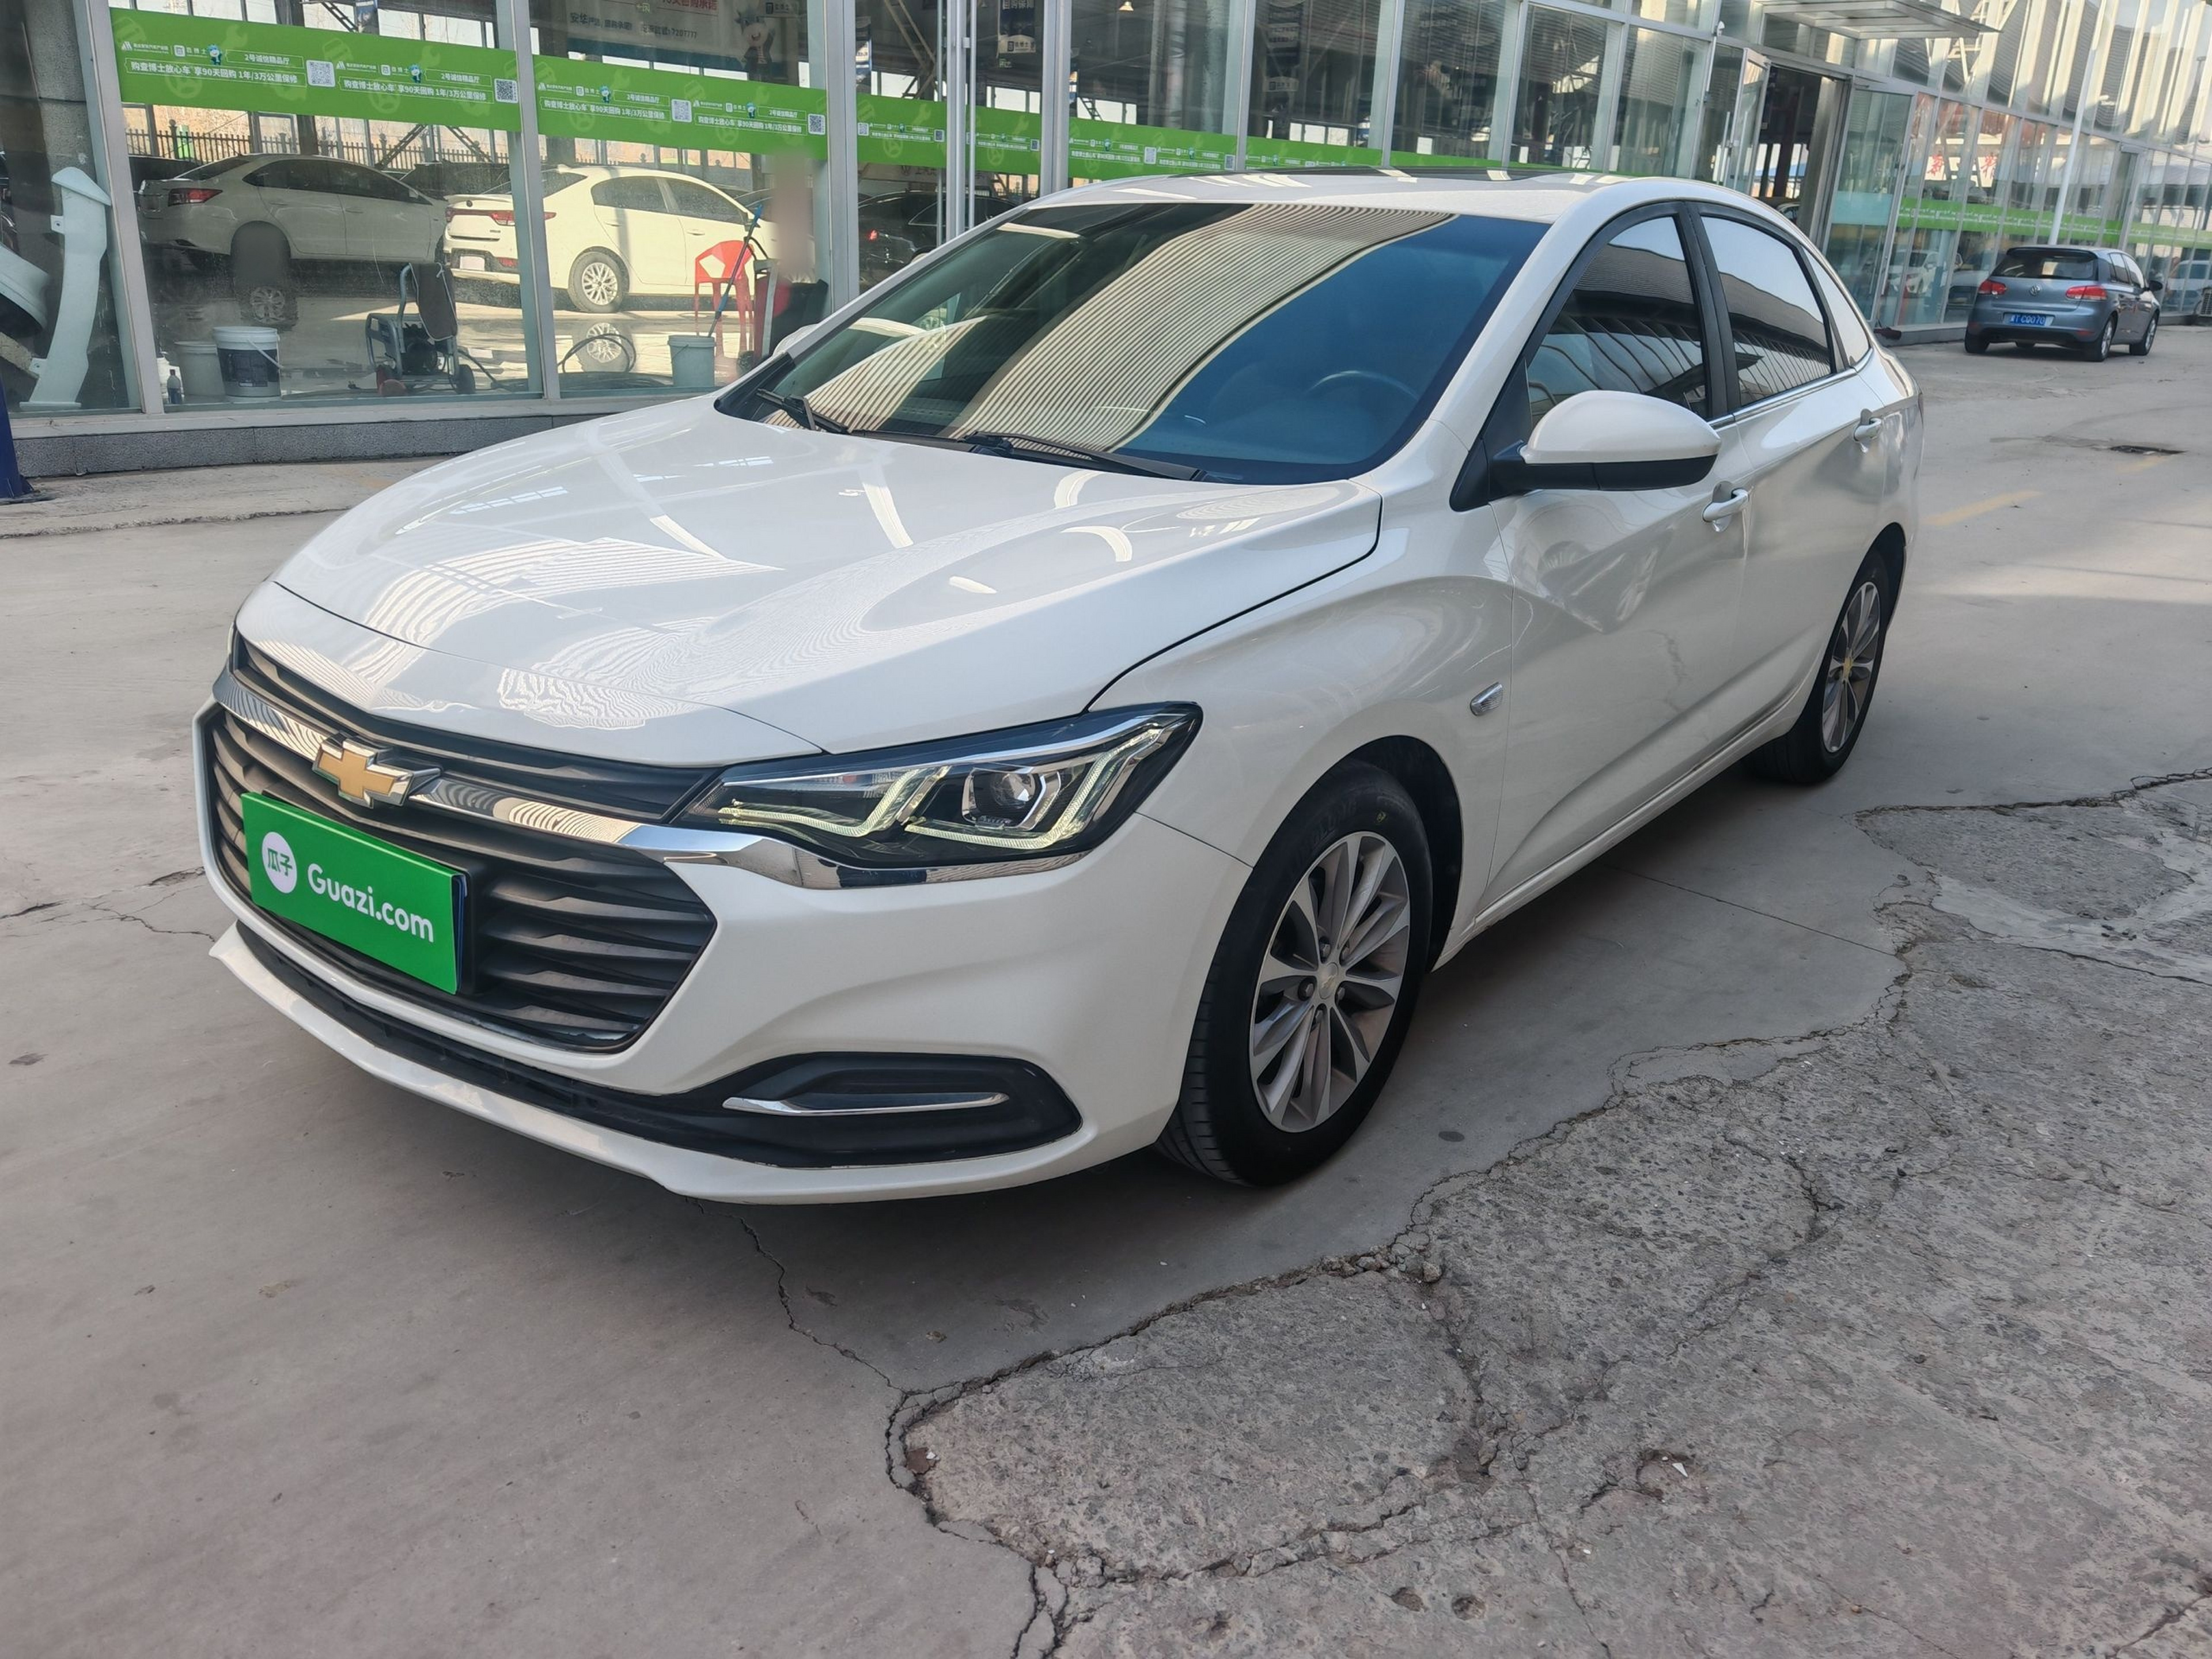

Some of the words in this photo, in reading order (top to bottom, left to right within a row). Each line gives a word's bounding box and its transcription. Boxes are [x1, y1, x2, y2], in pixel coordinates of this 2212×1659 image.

[131, 61, 191, 74] 购查博士放心车
[195, 67, 236, 78] 享90天回购
[238, 71, 297, 84] 1年/3万公里保修
[343, 79, 395, 92] 购查博士放心车
[397, 84, 434, 96] 享90天回购
[267, 848, 293, 876] 瓜子
[307, 863, 434, 943] Guazi.com
